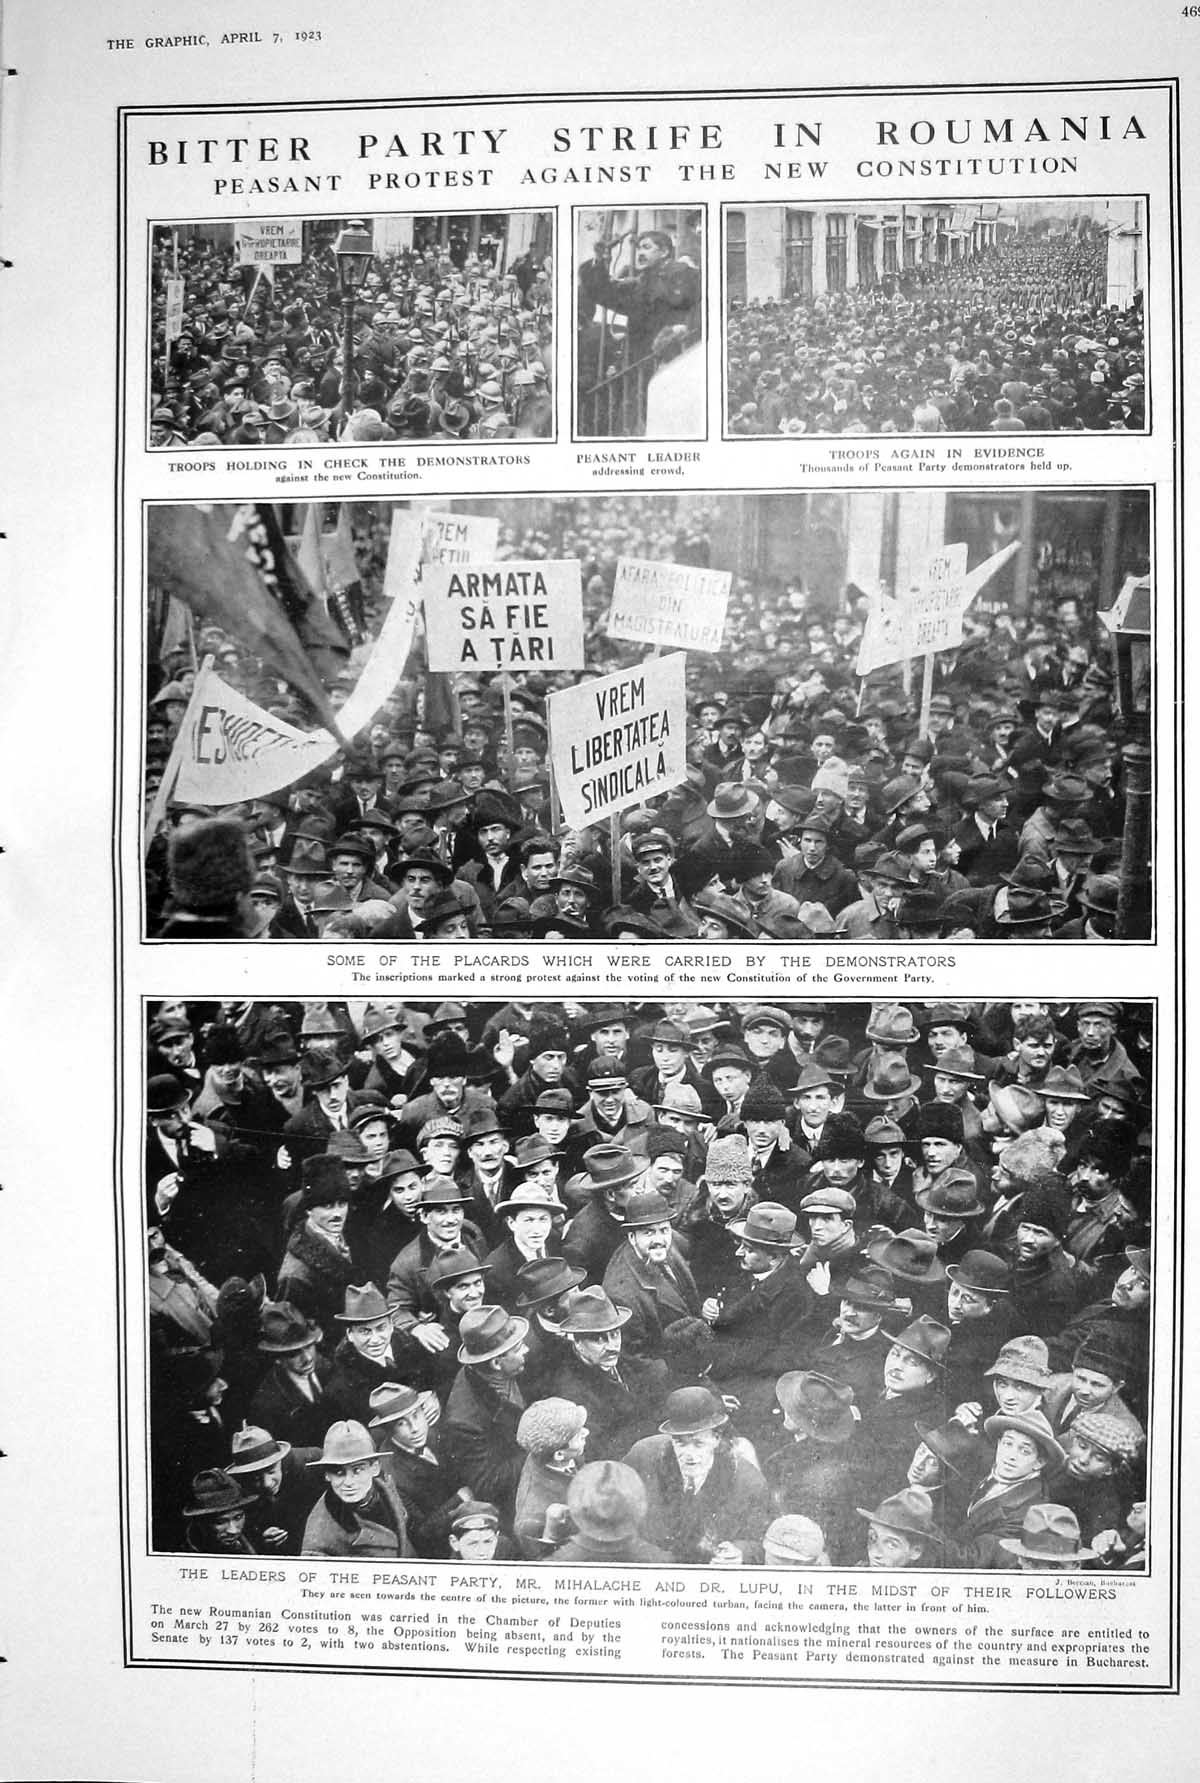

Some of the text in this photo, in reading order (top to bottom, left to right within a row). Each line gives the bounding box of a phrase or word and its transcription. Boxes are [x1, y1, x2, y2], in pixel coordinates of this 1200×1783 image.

[107, 39, 134, 50] THE
[145, 35, 209, 48] GRAPHIC,
[221, 32, 262, 44] APRIL
[296, 31, 321, 41] 1923
[148, 115, 1147, 165] BITTER PARTY STRIFE IN ROUMANIA
[214, 157, 1077, 195] PEASANT PROTEST AGAINST THE NEW CONSTITUTION
[260, 225, 284, 236] VREM
[577, 452, 700, 463] PEASANT LEADER
[829, 448, 1044, 459] TROOPS AGAIN IN EVIDENCE
[168, 456, 530, 472] TROOPS HOLDING IN CHECK THE DEMONSTRATORS
[592, 466, 644, 476] addressing
[800, 464, 854, 472] Thousands
[859, 463, 869, 472] of
[875, 463, 912, 472] Peasant
[919, 462, 946, 472] Party
[952, 462, 1025, 471] demonstrators
[1031, 462, 1051, 470] held
[275, 474, 308, 483] against
[314, 473, 329, 481] the
[357, 471, 422, 480] Constitution.
[447, 571, 548, 598] ARMATA
[460, 600, 549, 630] SĂ FIE
[460, 638, 479, 663] A
[596, 676, 645, 721] VREM
[571, 709, 670, 775] LIBERTATEA
[327, 955, 956, 967] SOME OF THE PLACARDS WHICH WERE CARRIED BY THE DEMONSTRATORS
[352, 972, 371, 981] The
[376, 972, 432, 982] inscriptions
[438, 972, 475, 981] marked
[491, 974, 522, 982] strong
[527, 974, 561, 983] protest
[566, 973, 600, 983] against
[606, 973, 622, 982] the
[627, 973, 659, 983] voting
[664, 973, 675, 984] of
[679, 973, 695, 982] the
[727, 973, 790, 982] Constitution
[796, 973, 807, 982] of
[812, 973, 828, 982] the
[834, 973, 898, 982] Government
[904, 974, 934, 983] Party.
[179, 1568, 208, 1579] THE
[222, 1570, 286, 1582] LEADERS
[299, 1572, 317, 1583] OF
[329, 1573, 359, 1583] THE
[373, 1574, 437, 1586] PEASANT
[451, 1576, 501, 1589] PARTY,
[516, 1578, 541, 1589] MR.
[555, 1579, 640, 1591] MIHALACHE
[656, 1582, 685, 1592] AND
[700, 1582, 725, 1593] DR.
[798, 1584, 812, 1595] IN
[826, 1585, 857, 1595] THE
[872, 1585, 917, 1597] MIDST
[931, 1586, 950, 1597] OF
[964, 1587, 1012, 1598] THEIR
[1026, 1586, 1116, 1600] FOLLOWERS
[151, 1604, 621, 1630] The new Roumanian Constitution was carried in the Chamber of Deputies
[661, 1621, 1150, 1639] concessions and acknowledging that the owners of the surface are entitled to
[152, 1632, 621, 1659] Senate by 137 votes to 2, with two abstentions. While respecting existing
[662, 1648, 1148, 1668] forests. The Peasant Party demonstrated against the measure in Bucharest.
